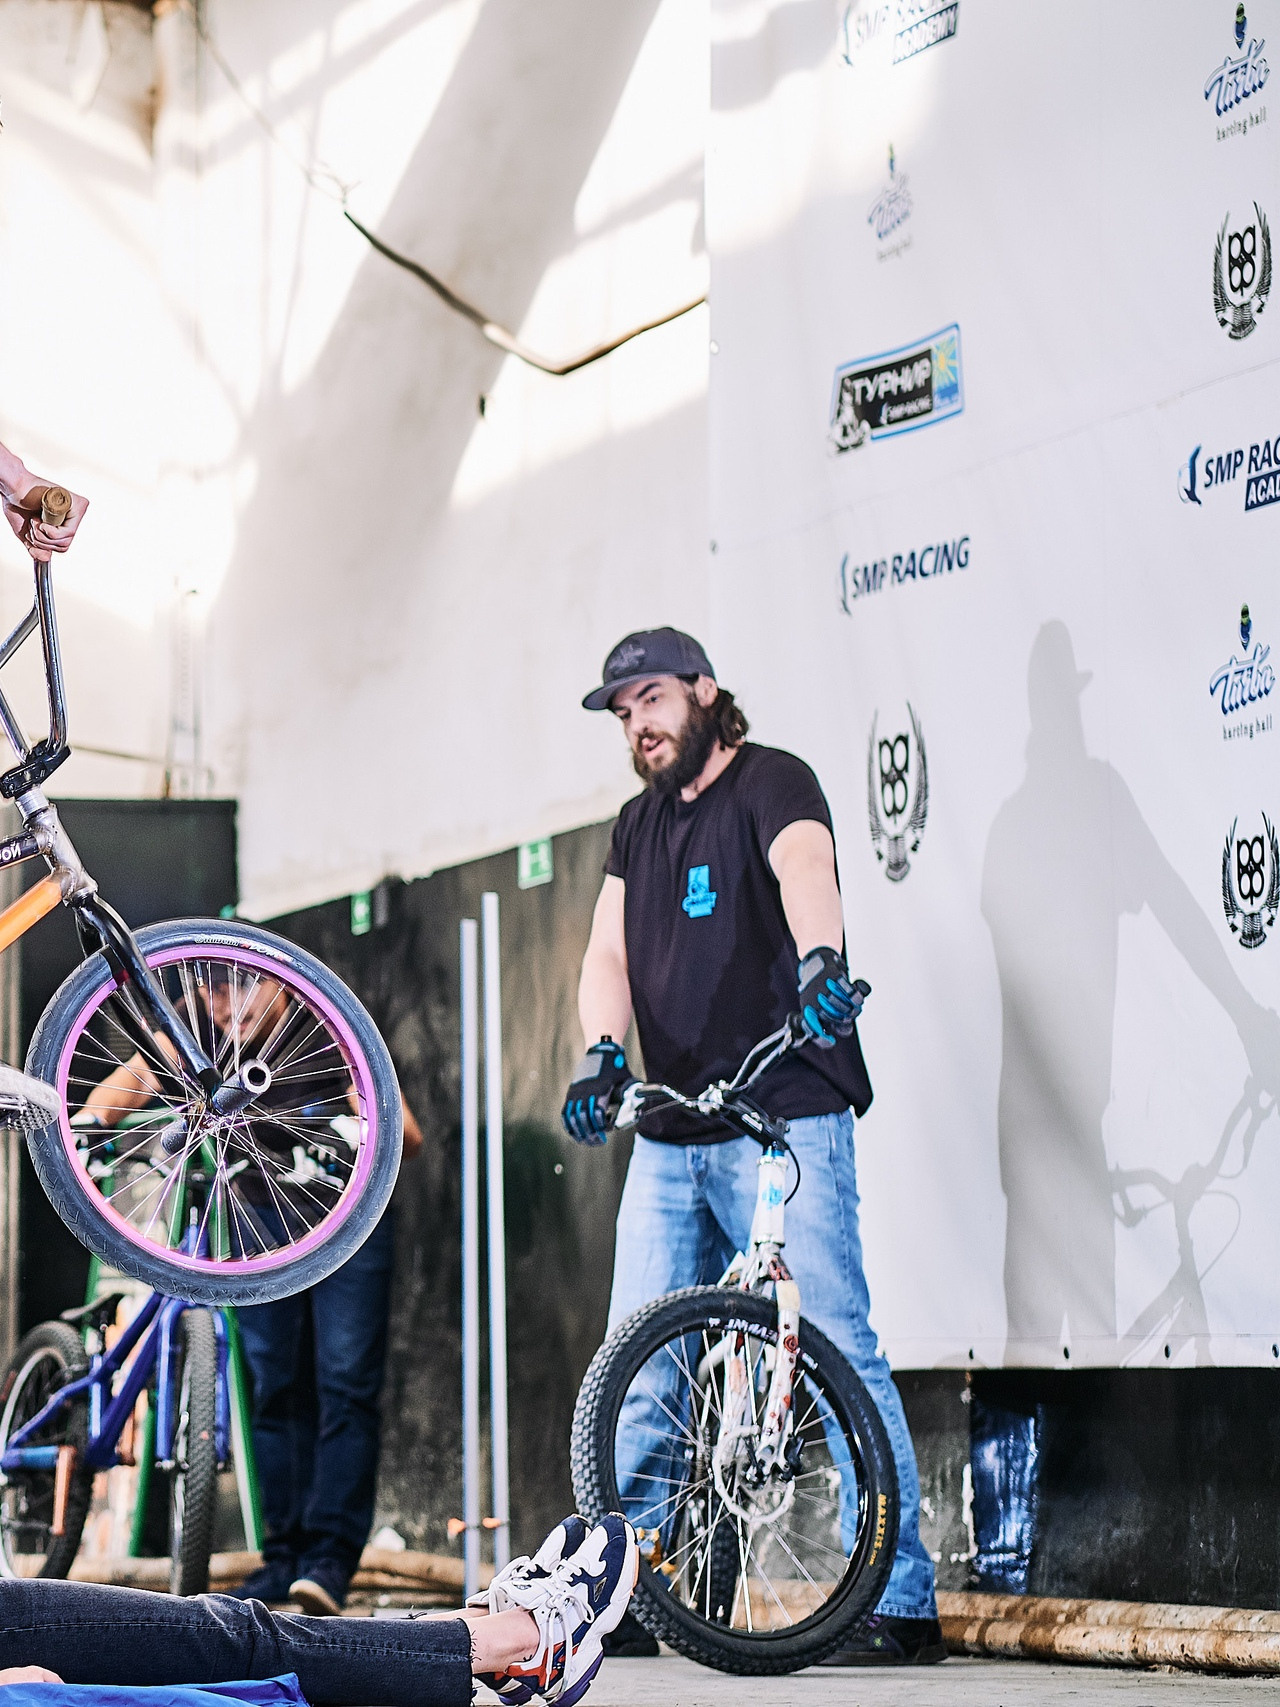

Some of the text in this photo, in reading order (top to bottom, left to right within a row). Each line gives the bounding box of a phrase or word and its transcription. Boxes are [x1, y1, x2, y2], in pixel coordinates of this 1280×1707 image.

[852, 357, 931, 405] ТУРНИР
[1204, 449, 1244, 488] SMP
[852, 535, 970, 599] SMP RACING
[873, 1493, 887, 1550] MAXXIS
